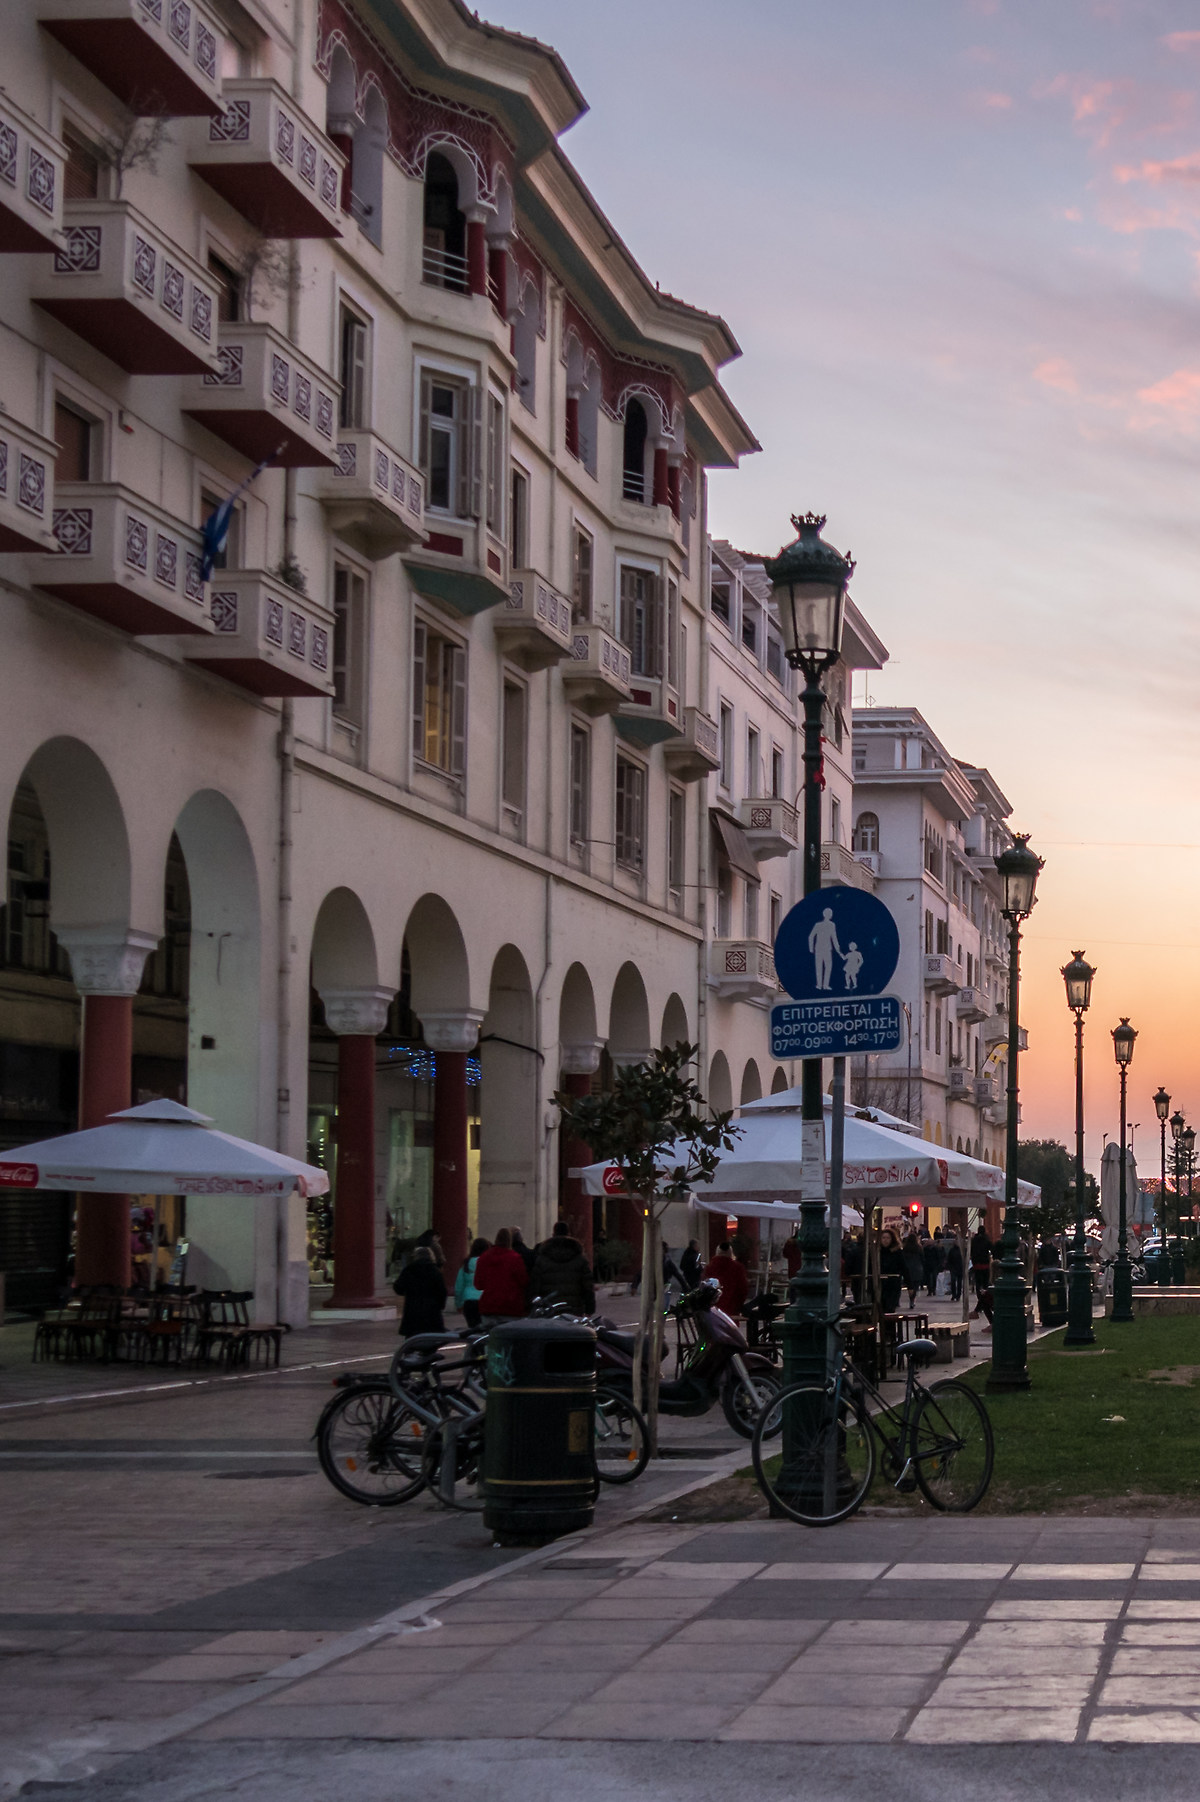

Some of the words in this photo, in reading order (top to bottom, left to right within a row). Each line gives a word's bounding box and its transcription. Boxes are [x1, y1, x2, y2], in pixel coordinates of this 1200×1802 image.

[782, 1003, 871, 1021] ΕΠΙΤΡΕΠΕΤΑΙ
[881, 1002, 891, 1014] Η
[773, 1016, 898, 1036] ΦΟΡΤΟΕΚΦΟΡΤΩΣΗ
